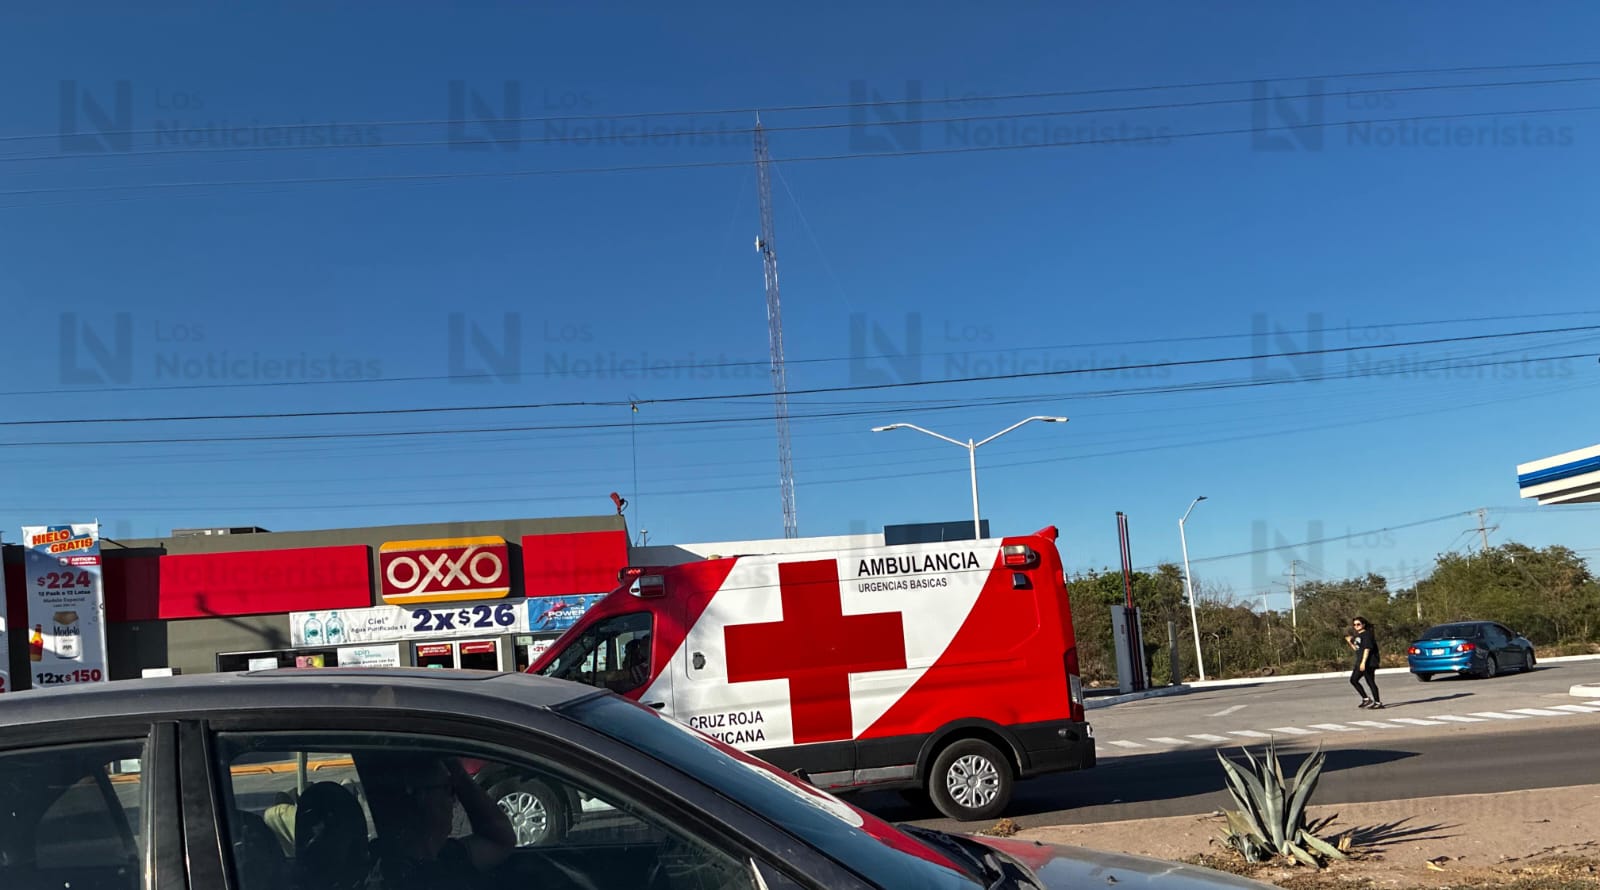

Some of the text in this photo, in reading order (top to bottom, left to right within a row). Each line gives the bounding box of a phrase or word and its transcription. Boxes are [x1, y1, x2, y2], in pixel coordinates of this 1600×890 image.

[32, 529, 70, 545] HIELO
[50, 538, 94, 553] GRATIS
[386, 551, 503, 590] OXXO
[858, 551, 980, 577] AMBULANCIA
[37, 571, 91, 589] $224
[858, 577, 947, 593] URGENCIAS BASICAS
[412, 604, 516, 632] 2x$26
[53, 626, 80, 635] Modelo
[690, 711, 764, 728] CRUZ ROJA
[712, 729, 765, 744] XICANA
